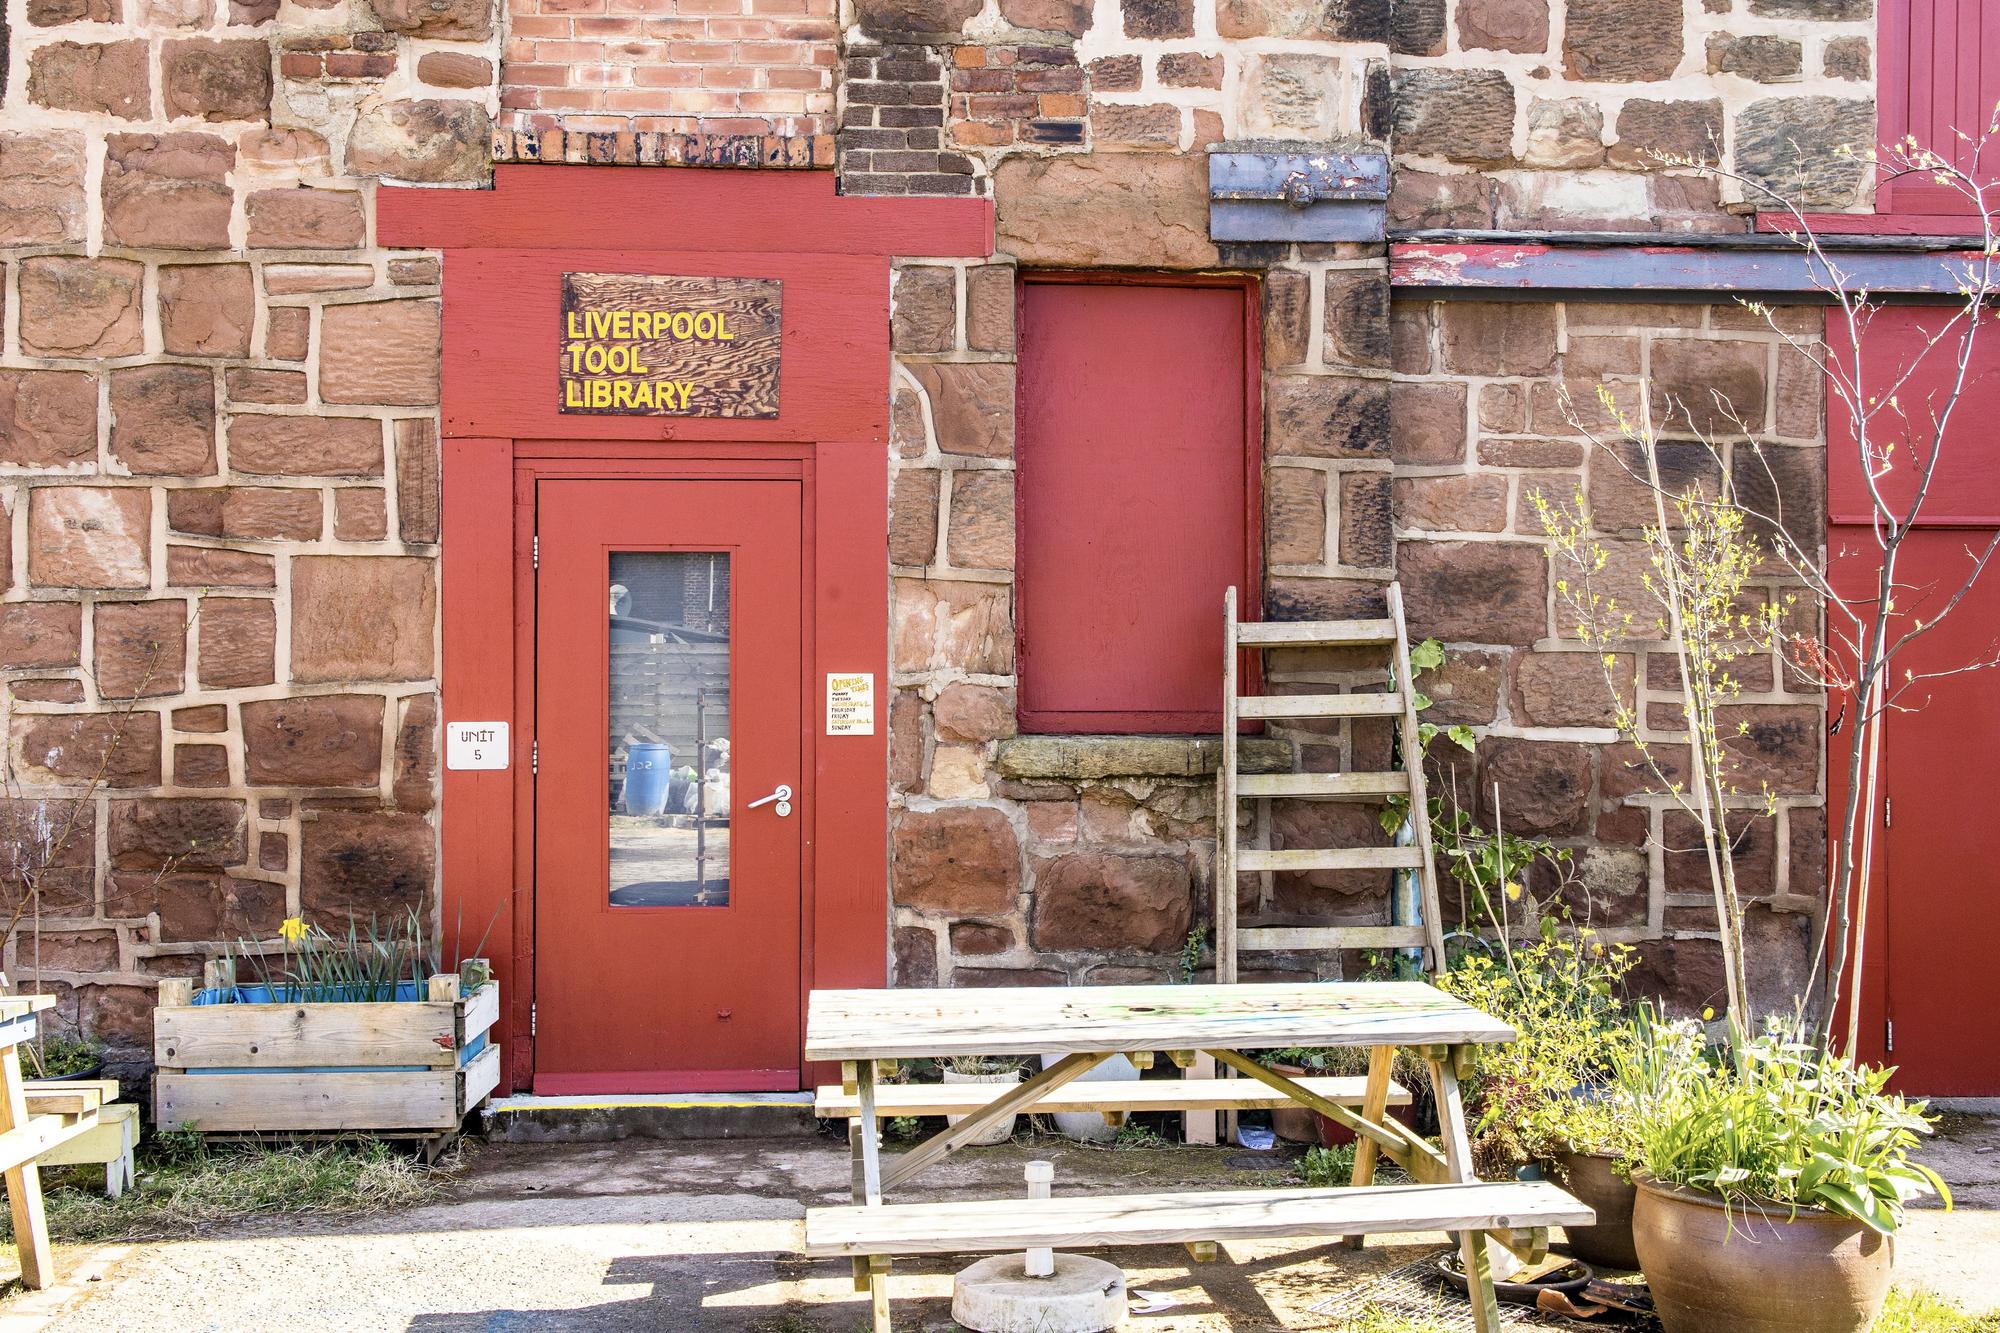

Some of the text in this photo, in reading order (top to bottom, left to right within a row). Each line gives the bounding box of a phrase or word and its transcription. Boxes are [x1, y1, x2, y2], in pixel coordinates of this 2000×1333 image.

[567, 311, 734, 340] LIVERPOOL
[567, 345, 648, 374] TOOL
[566, 379, 694, 410] LIBRARY
[831, 676, 864, 691] OPENING
[461, 730, 495, 742] UNIT
[474, 749, 482, 760] 5
